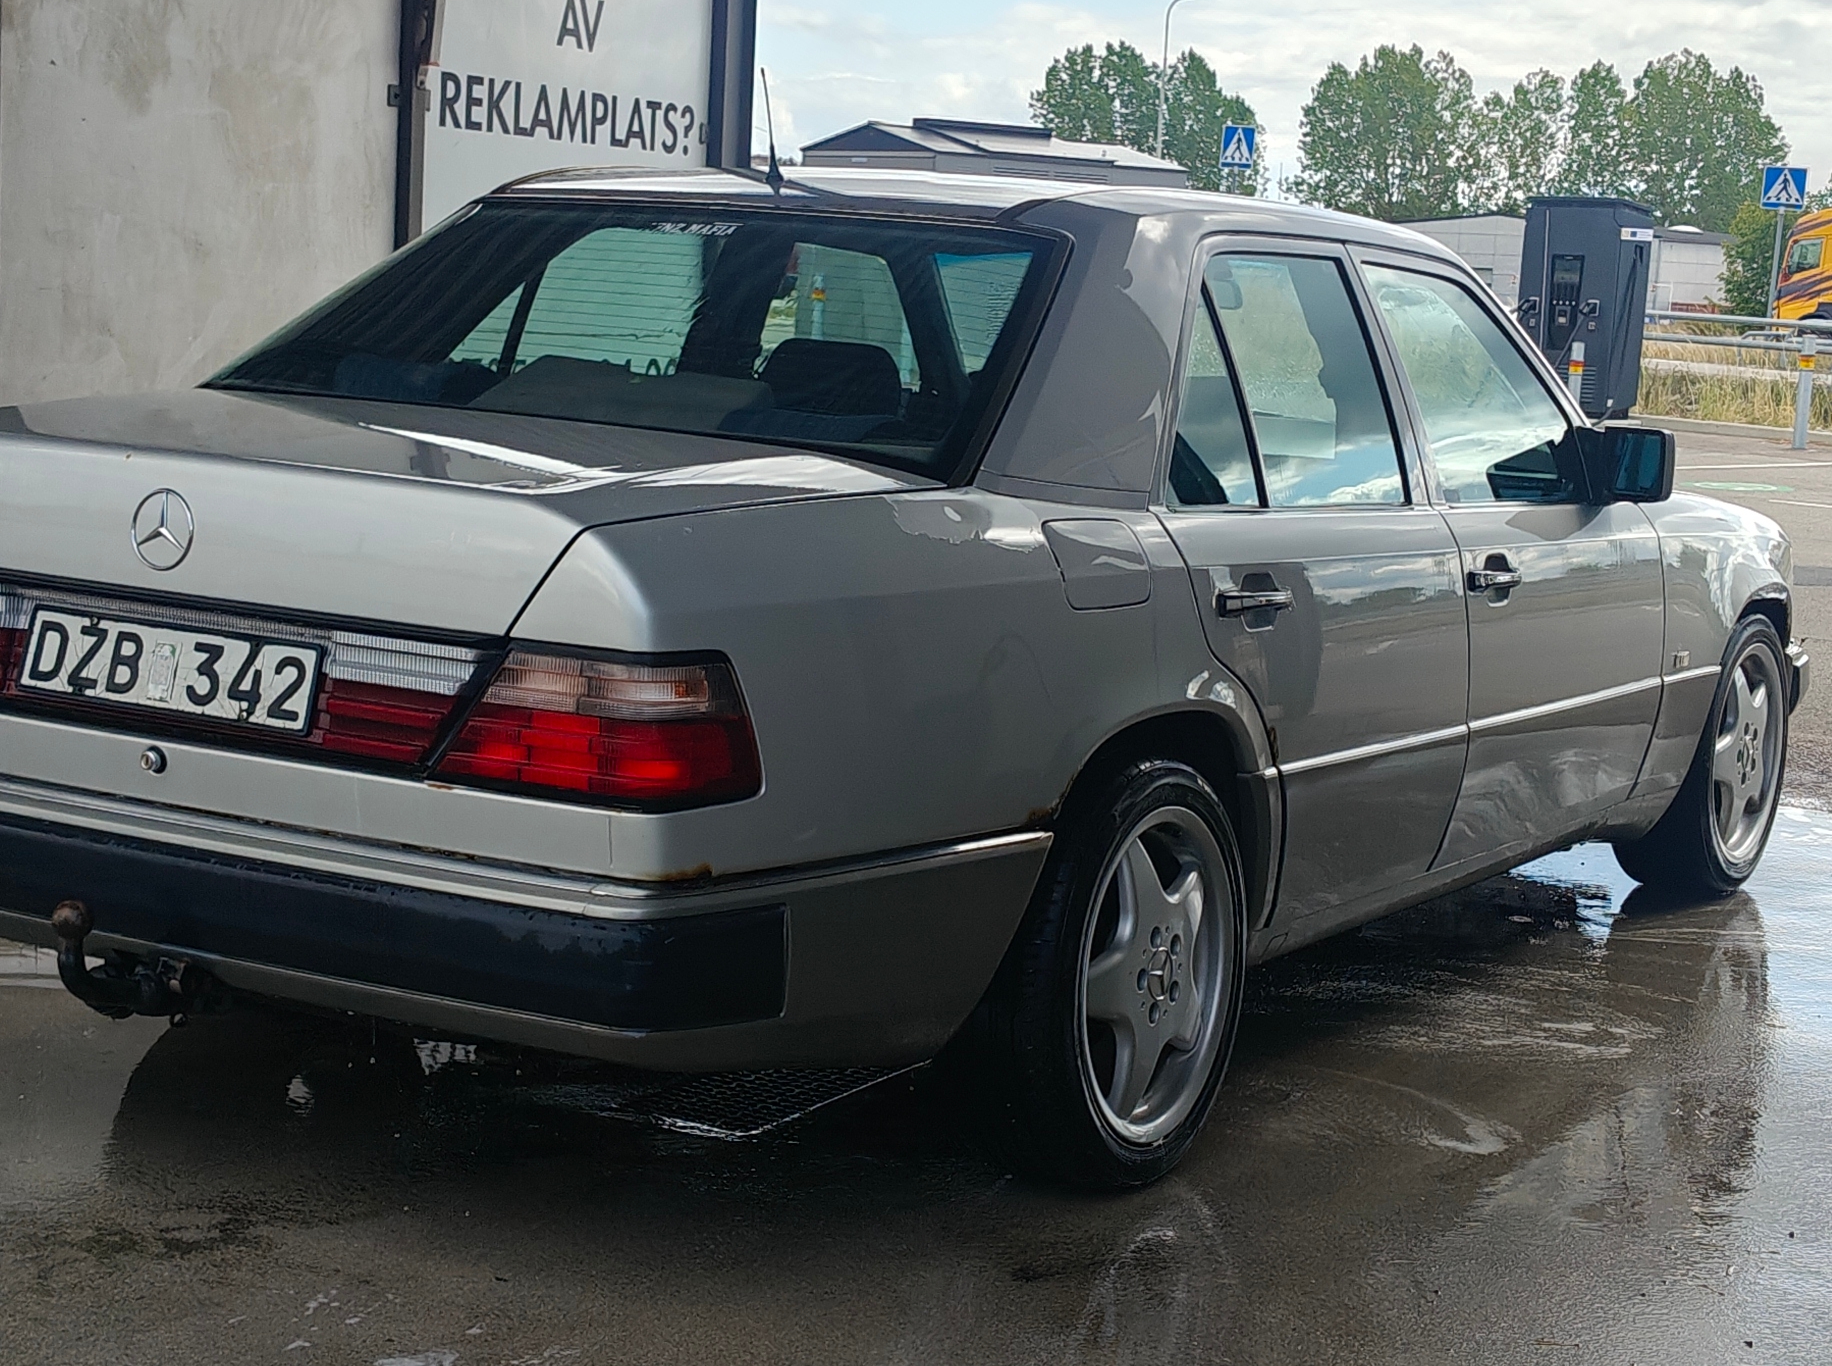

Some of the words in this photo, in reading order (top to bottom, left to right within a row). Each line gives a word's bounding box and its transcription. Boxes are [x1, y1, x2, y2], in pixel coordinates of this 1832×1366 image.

[438, 70, 695, 156] REKLAMPLATS?
[684, 223, 738, 236] MAFIA
[29, 619, 143, 694] DZB
[185, 641, 307, 722] 342
